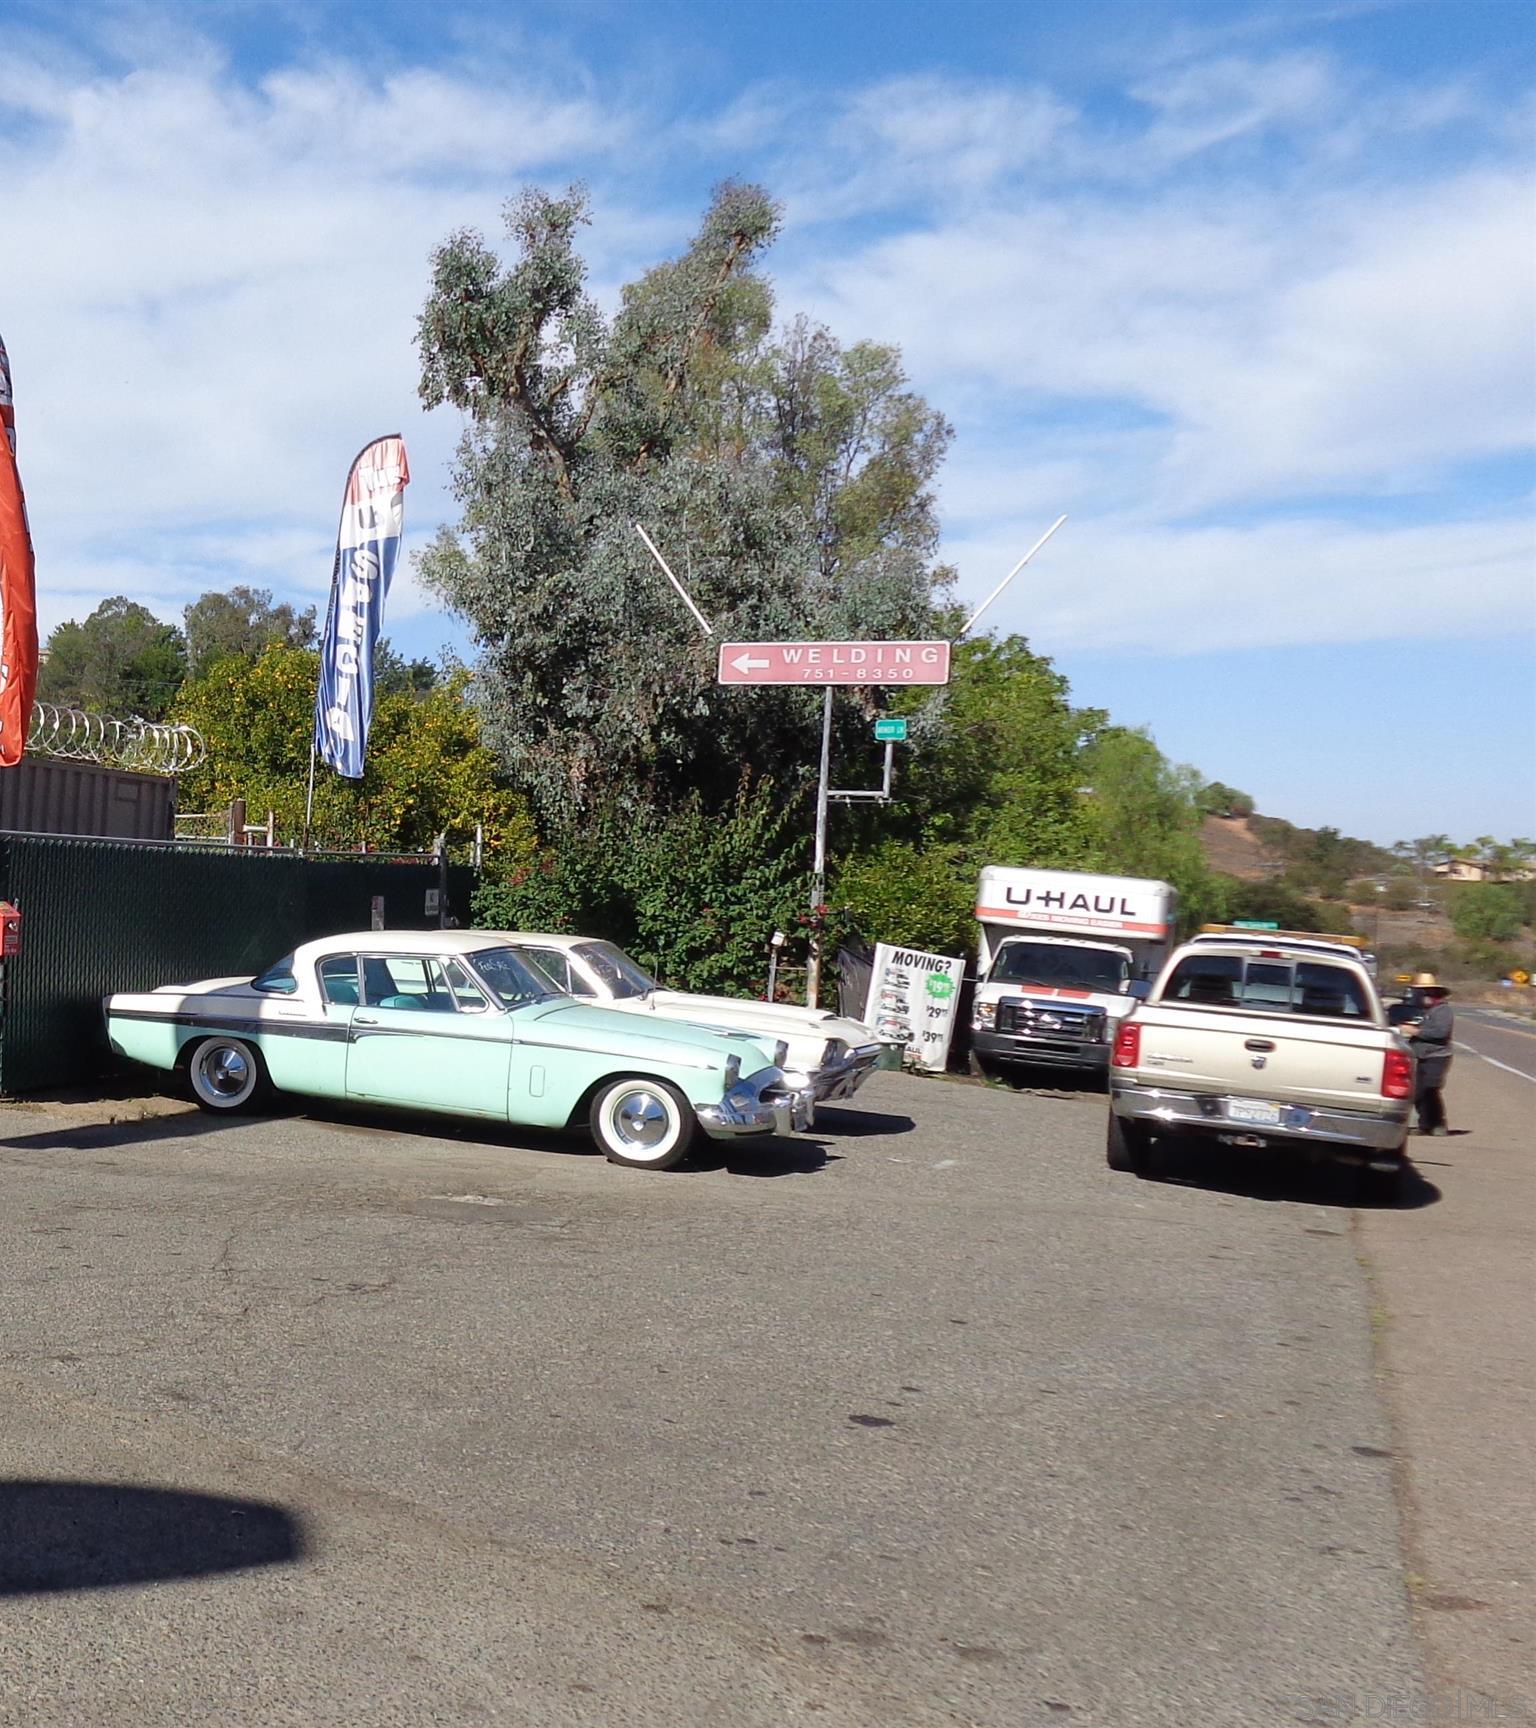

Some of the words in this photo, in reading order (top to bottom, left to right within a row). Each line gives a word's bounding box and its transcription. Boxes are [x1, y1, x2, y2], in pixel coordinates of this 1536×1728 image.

[783, 648, 938, 664] WELDING
[1005, 887, 1136, 916] U-HAUL
[891, 951, 952, 974] MOVING?
